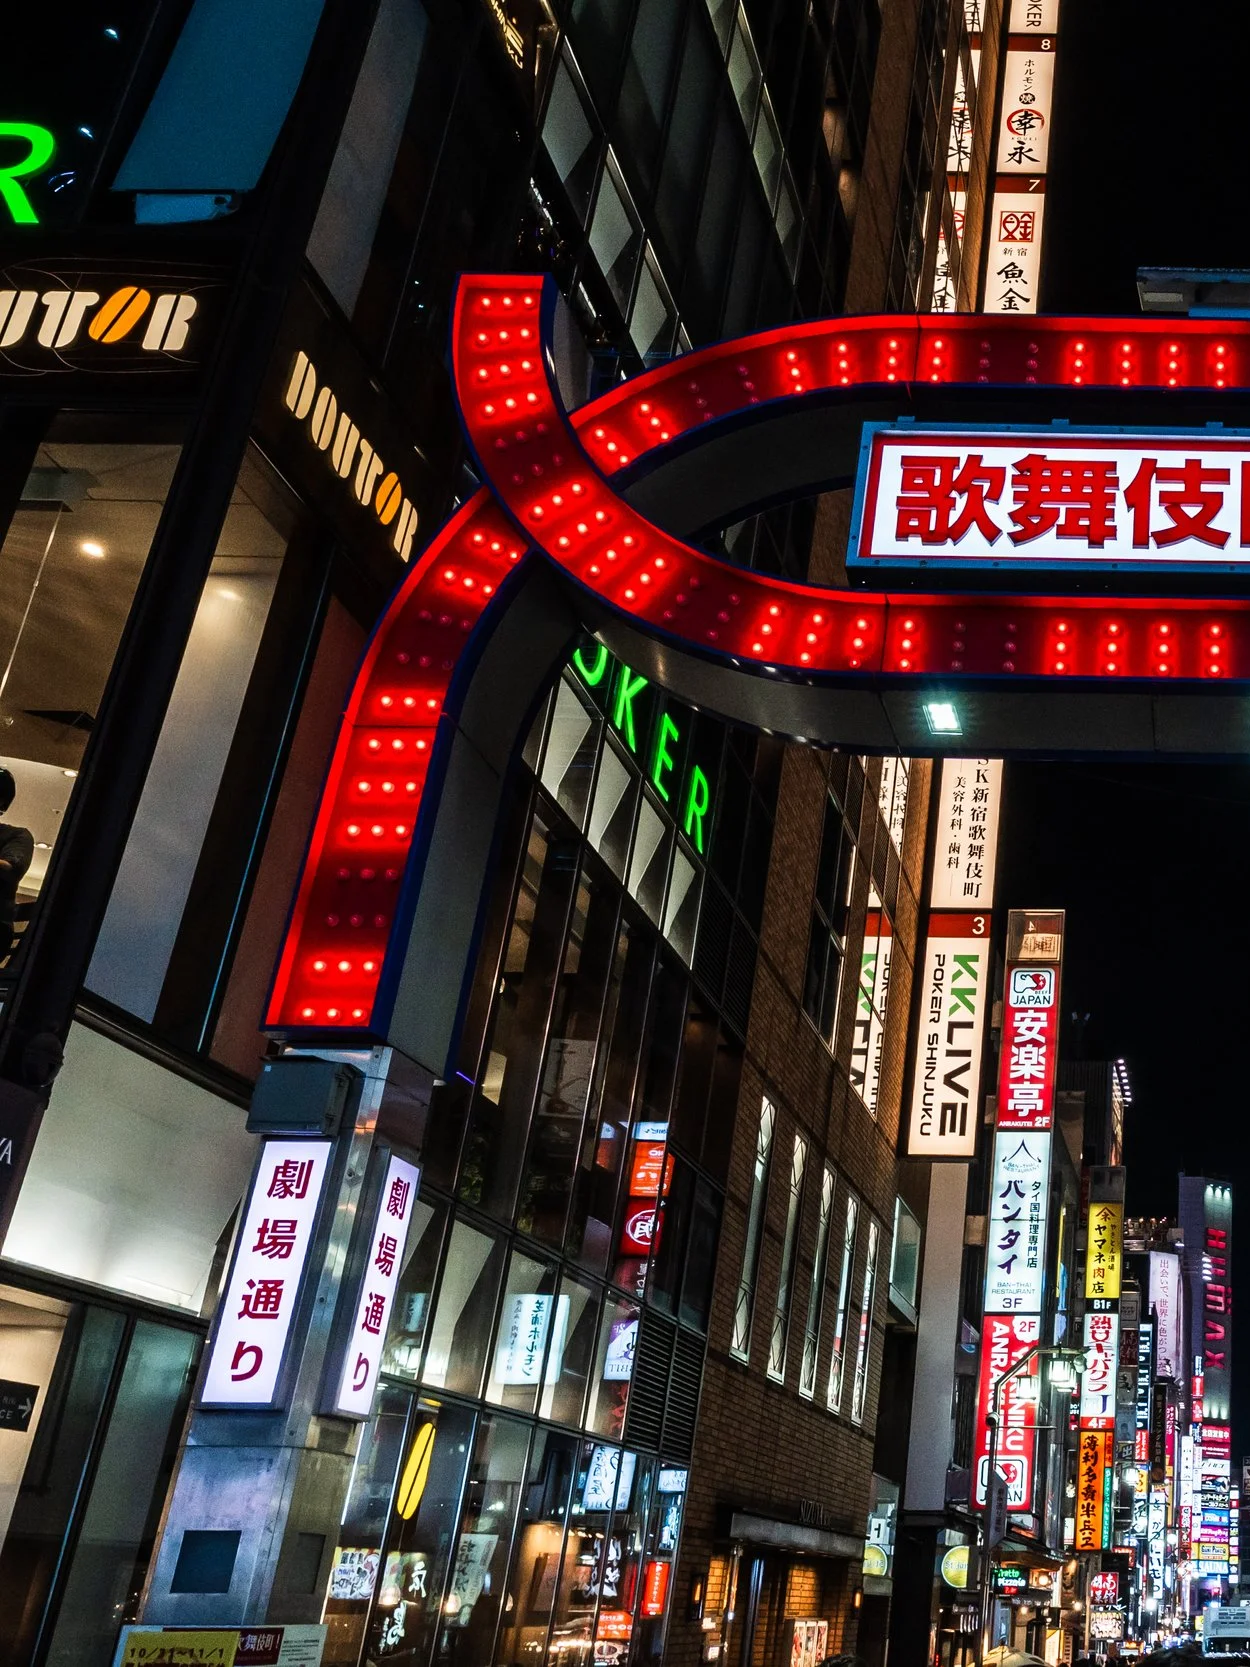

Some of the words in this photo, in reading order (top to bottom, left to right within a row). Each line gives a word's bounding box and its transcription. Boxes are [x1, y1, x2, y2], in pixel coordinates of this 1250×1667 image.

[1041, 39, 1050, 50] 8
[1028, 180, 1040, 191] 7
[997, 262, 1030, 310] 魚金
[285, 351, 419, 562] DOUTOR
[972, 917, 985, 934] 3
[929, 954, 945, 1023] POKER
[1013, 995, 1051, 1005] JAPAN
[939, 954, 979, 1137] KKLIVE
[1008, 1009, 1048, 1117] 安楽亭
[920, 1032, 939, 1136] SHINJUKU
[1034, 1117, 1050, 1127] 2F
[997, 1180, 1025, 1275] バンタイ
[1027, 1181, 1041, 1268] タイ国料理専門店
[231, 1159, 314, 1382] 劇場通り
[353, 1177, 409, 1392] 劇場通り
[1002, 1298, 1023, 1309] 3F
[1019, 1321, 1036, 1333] 2F
[1093, 1299, 1112, 1309] B1F
[1088, 1418, 1106, 1428] 4F
